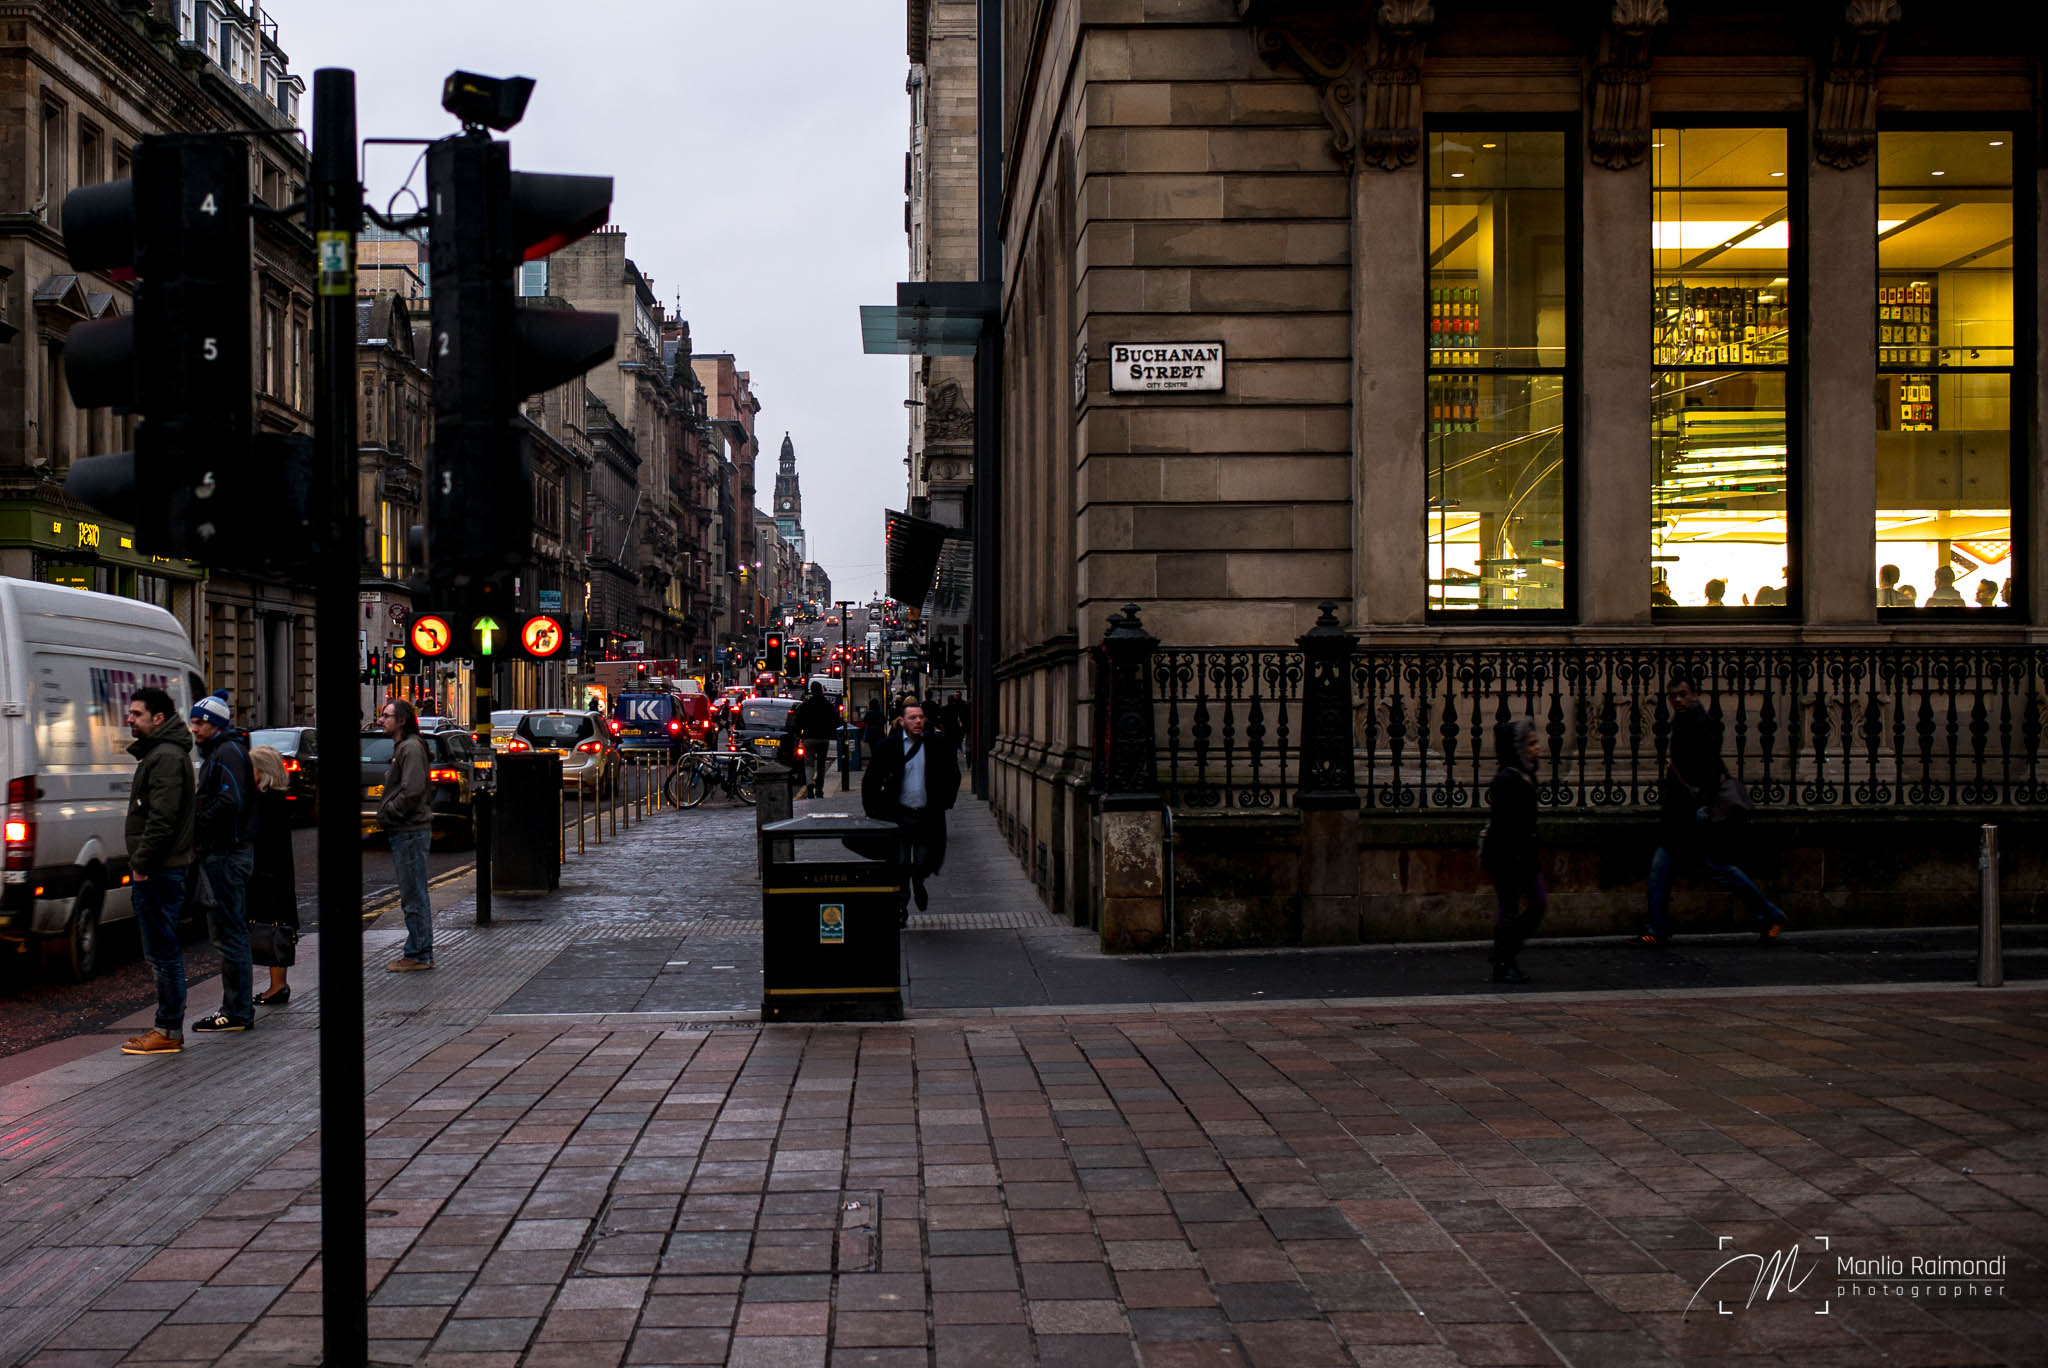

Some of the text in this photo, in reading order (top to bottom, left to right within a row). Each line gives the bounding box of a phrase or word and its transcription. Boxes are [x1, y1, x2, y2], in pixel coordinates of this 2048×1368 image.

[200, 192, 218, 216] 4
[203, 336, 219, 360] 5
[439, 332, 450, 357] 2
[1115, 347, 1219, 363] BUCHANAN
[1130, 364, 1206, 380] STREET
[442, 471, 452, 494] 3
